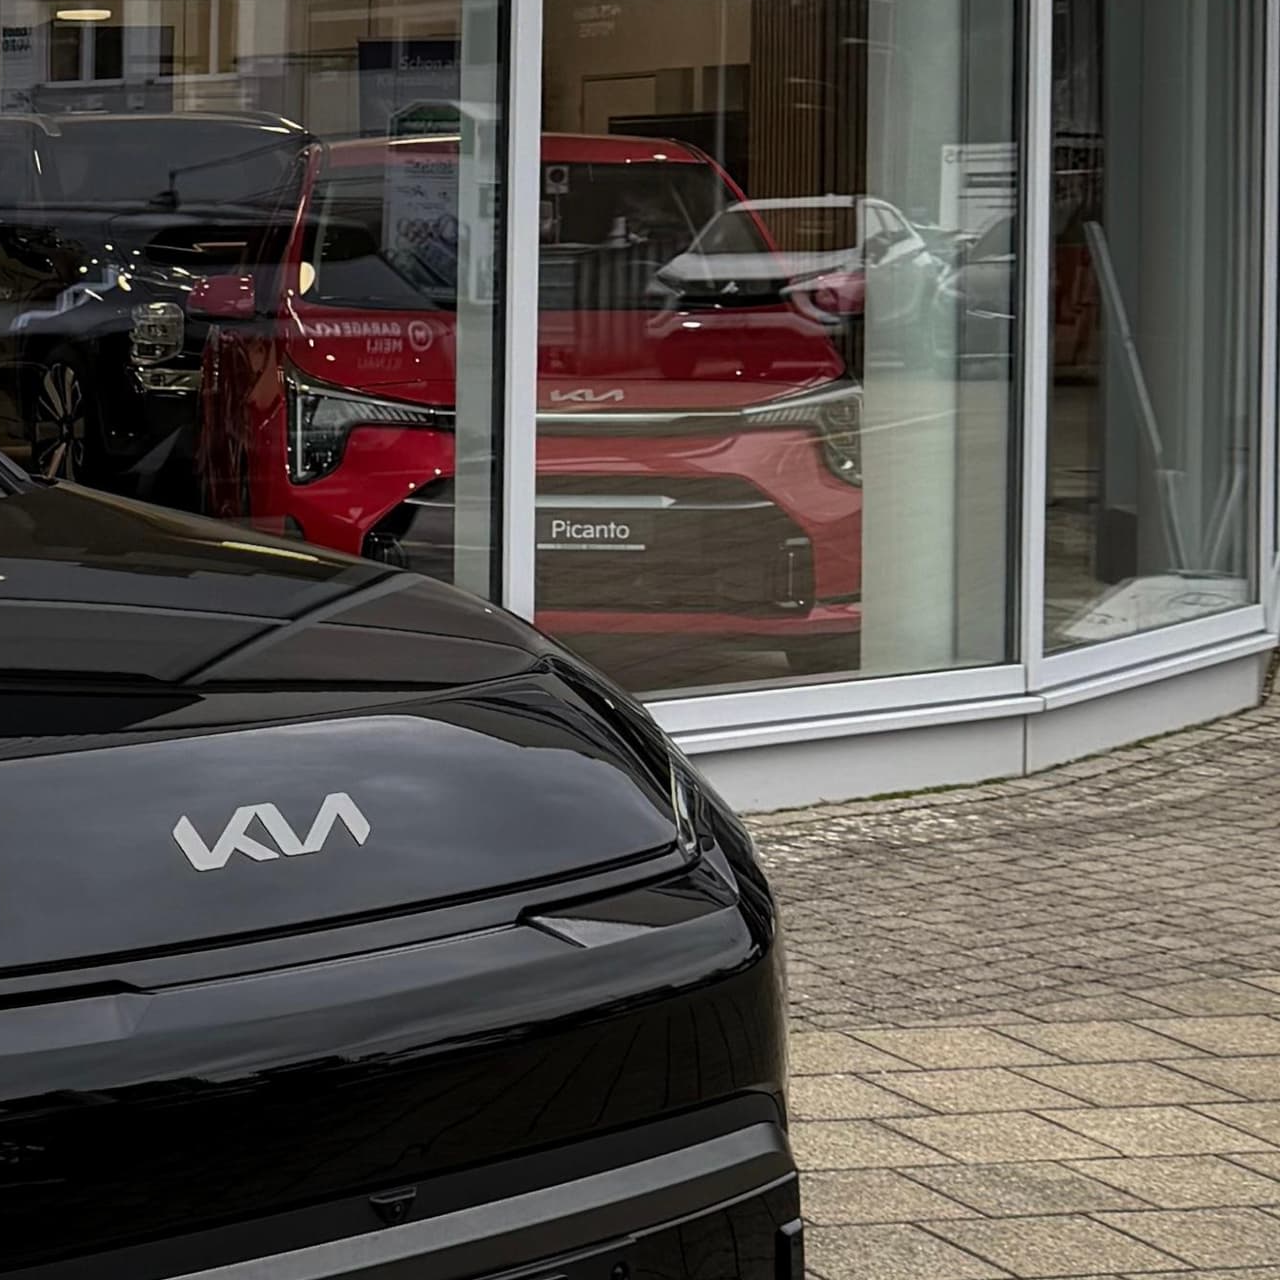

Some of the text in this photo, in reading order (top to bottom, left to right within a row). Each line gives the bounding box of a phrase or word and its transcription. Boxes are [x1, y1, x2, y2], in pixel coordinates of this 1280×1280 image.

[550, 389, 625, 402] KIA
[551, 520, 630, 539] Picanto
[172, 791, 371, 872] KIA
